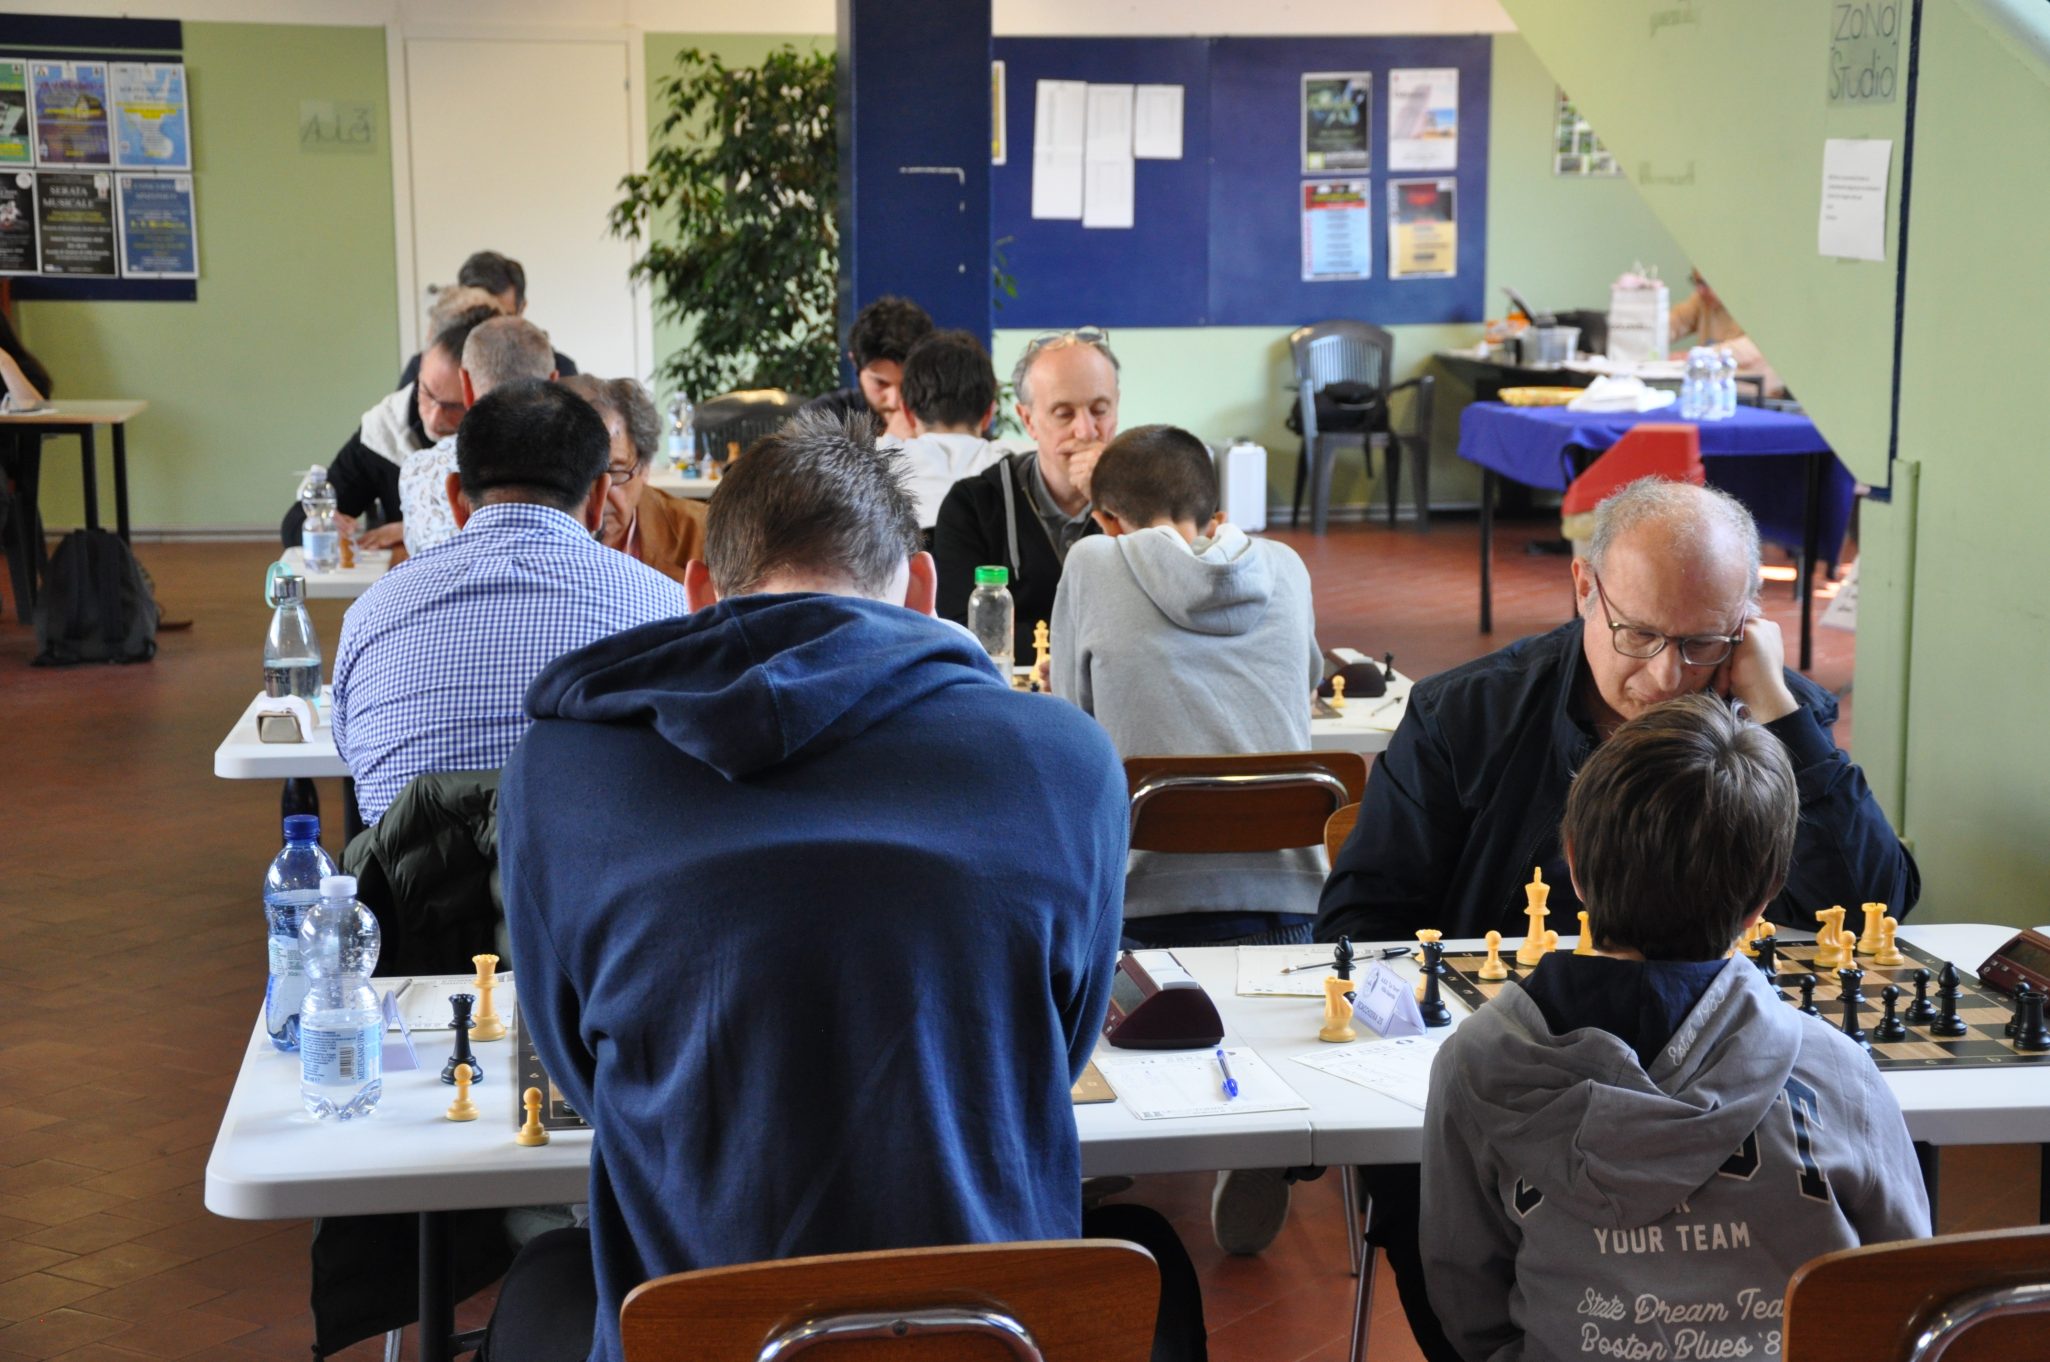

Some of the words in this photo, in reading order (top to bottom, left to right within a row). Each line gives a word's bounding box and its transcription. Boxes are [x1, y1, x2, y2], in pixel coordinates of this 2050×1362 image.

[42, 197, 94, 209] MUSICALE
[49, 184, 88, 197] SERATA
[1593, 1225, 1665, 1255] YOUR
[1675, 1221, 1751, 1251] TEAM
[1577, 1287, 1627, 1321] State
[1634, 1293, 1729, 1325] Dream
[1736, 1288, 1785, 1321] Tea
[1581, 1322, 1668, 1361] Boston
[1674, 1328, 1754, 1361] Blues
